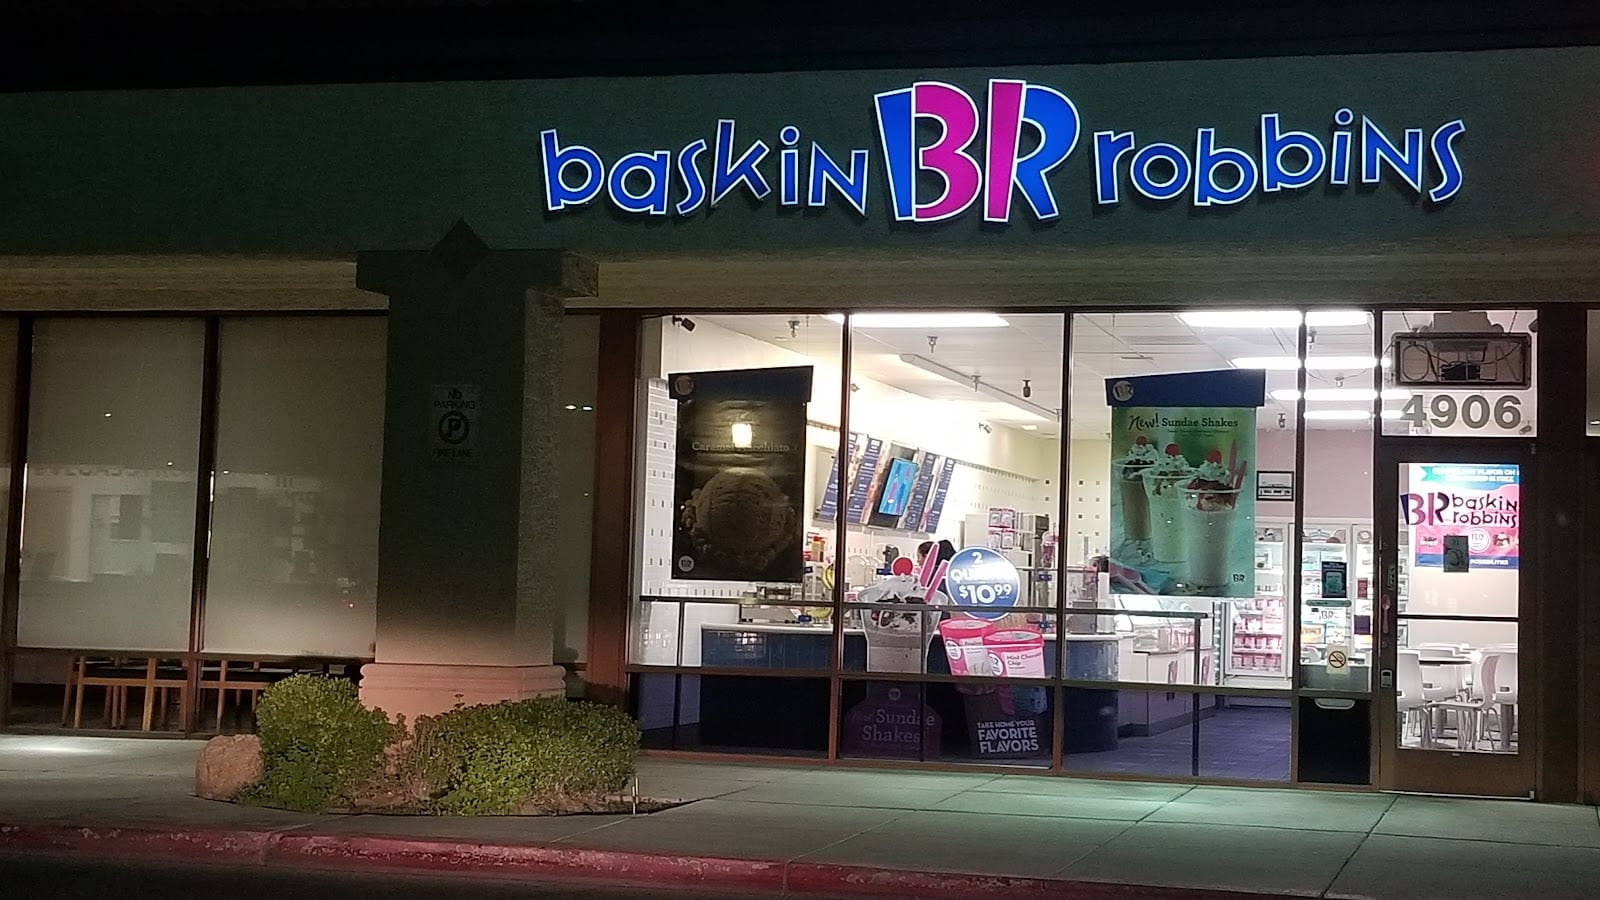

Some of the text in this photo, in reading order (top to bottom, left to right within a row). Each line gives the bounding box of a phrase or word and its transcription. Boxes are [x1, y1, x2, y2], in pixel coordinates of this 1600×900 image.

[540, 78, 1466, 223] baskin BR robbins
[447, 389, 463, 400] NO
[434, 400, 476, 410] PARKING
[1400, 394, 1522, 430] 4906
[1161, 416, 1199, 428] Sundae
[1201, 416, 1239, 428] Shakes
[1400, 492, 1518, 526] BR baskin
[1452, 510, 1517, 529] robbins
[971, 551, 984, 564] 2
[976, 719, 1035, 729] TAKE HOME YOUR
[861, 724, 921, 744] Shakes
[977, 726, 1038, 741] FAVORITE
[979, 738, 1040, 754] FLAVORS
